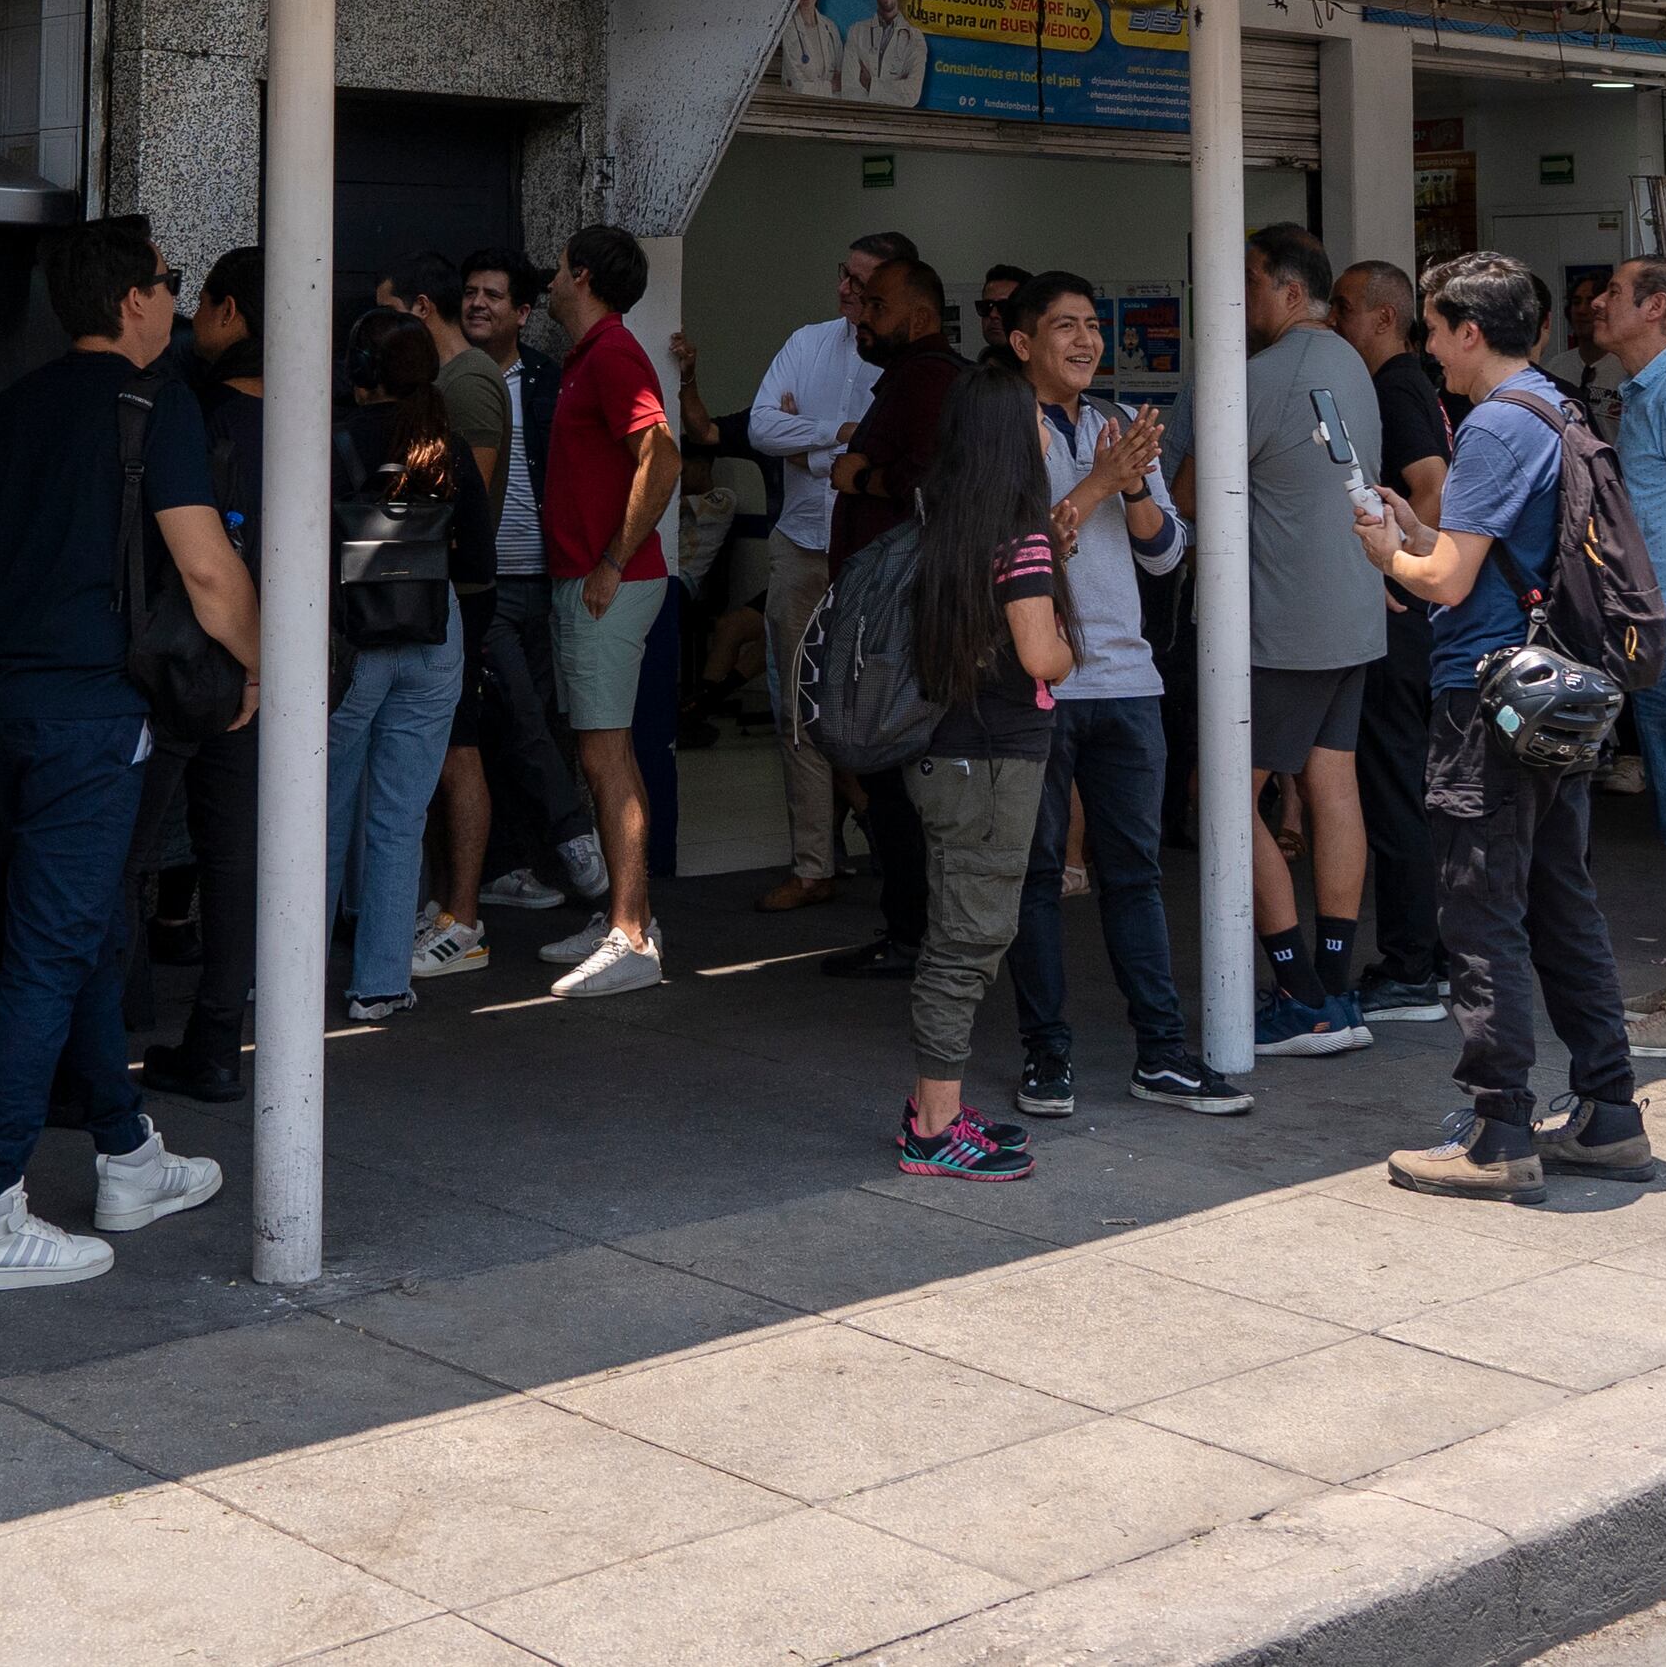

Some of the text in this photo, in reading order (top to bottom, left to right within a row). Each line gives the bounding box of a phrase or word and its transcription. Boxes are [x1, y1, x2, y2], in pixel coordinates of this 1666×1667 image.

[1066, 3, 1091, 22] hay
[946, 13, 977, 28] para
[980, 18, 997, 31] un
[1000, 18, 1038, 35] BUEN
[934, 60, 1004, 80] Consultorios
[1005, 69, 1019, 81] en
[1046, 73, 1057, 85] el
